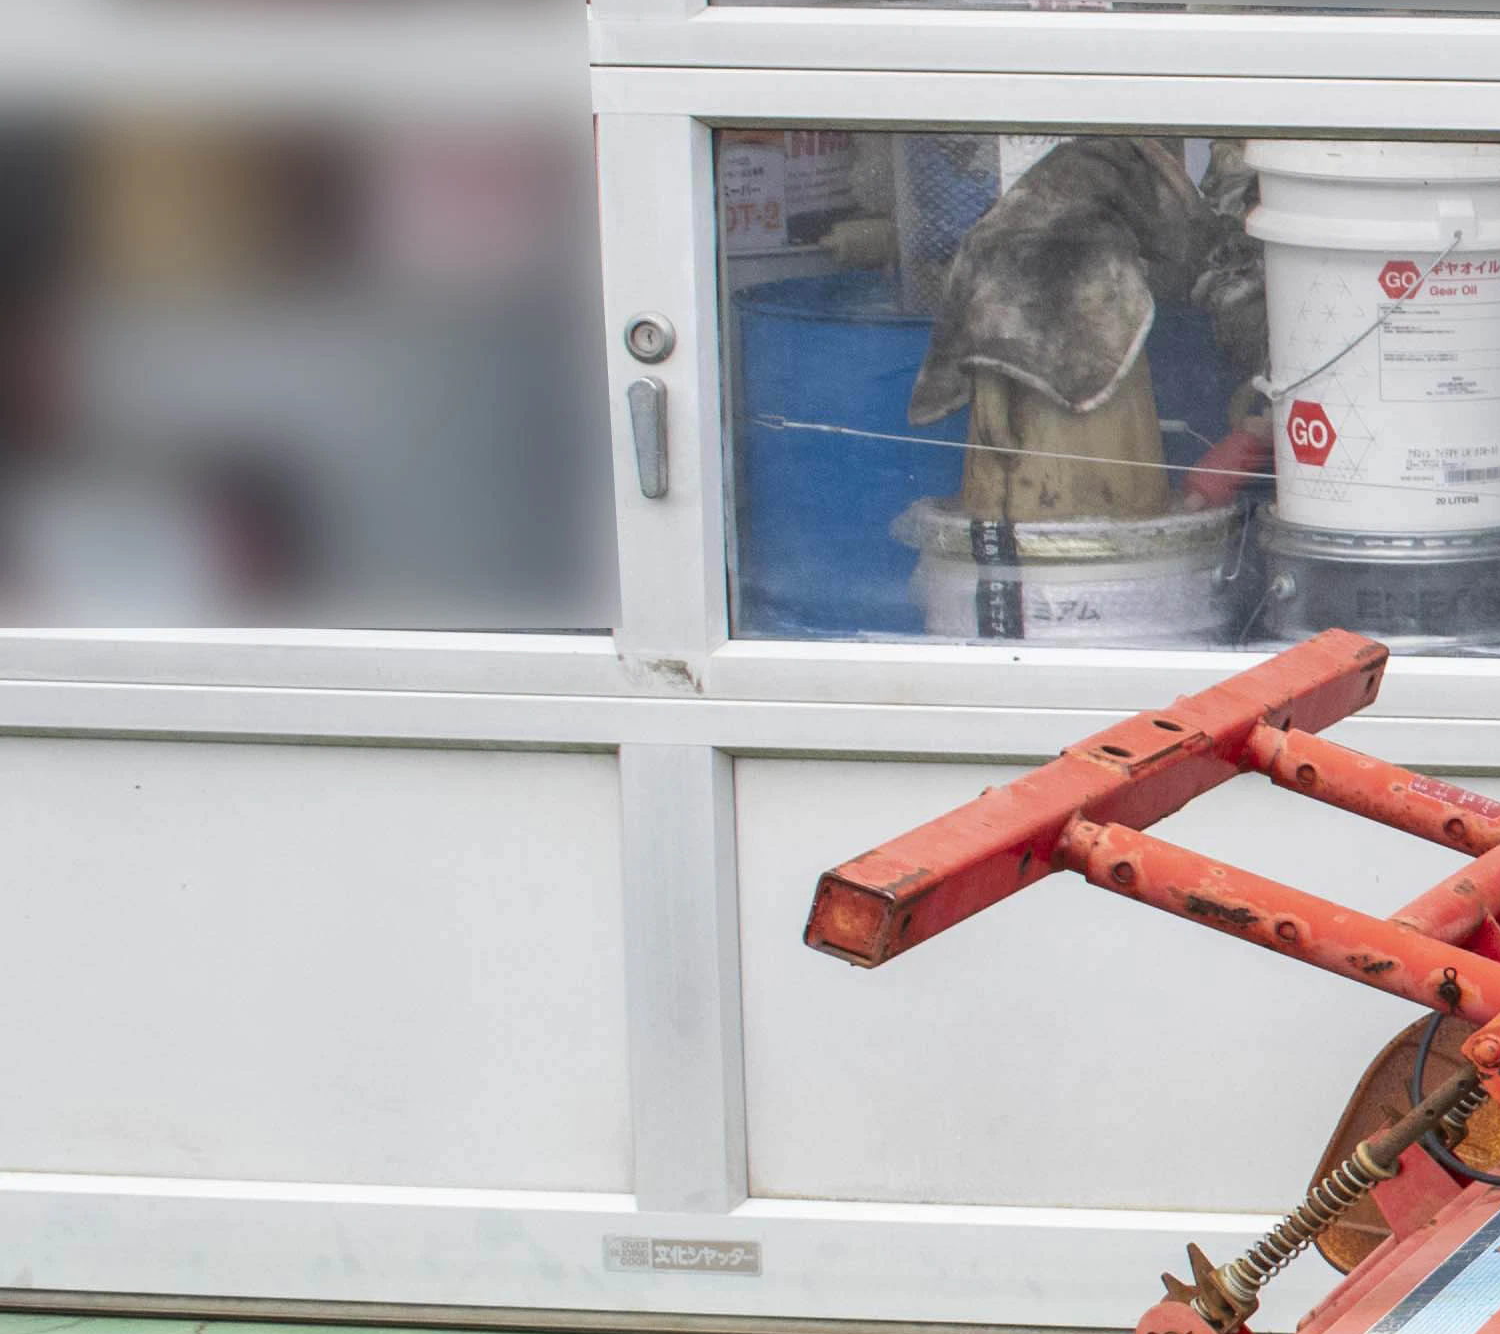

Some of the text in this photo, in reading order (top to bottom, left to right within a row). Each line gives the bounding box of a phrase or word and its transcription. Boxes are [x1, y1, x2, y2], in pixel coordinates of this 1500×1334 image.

[1431, 259, 1500, 275] ギヤオイル
[1386, 271, 1418, 290] GO
[1430, 285, 1477, 296] Gear Oil
[1291, 417, 1328, 449] GO
[1436, 495, 1479, 505] 20 LITERS
